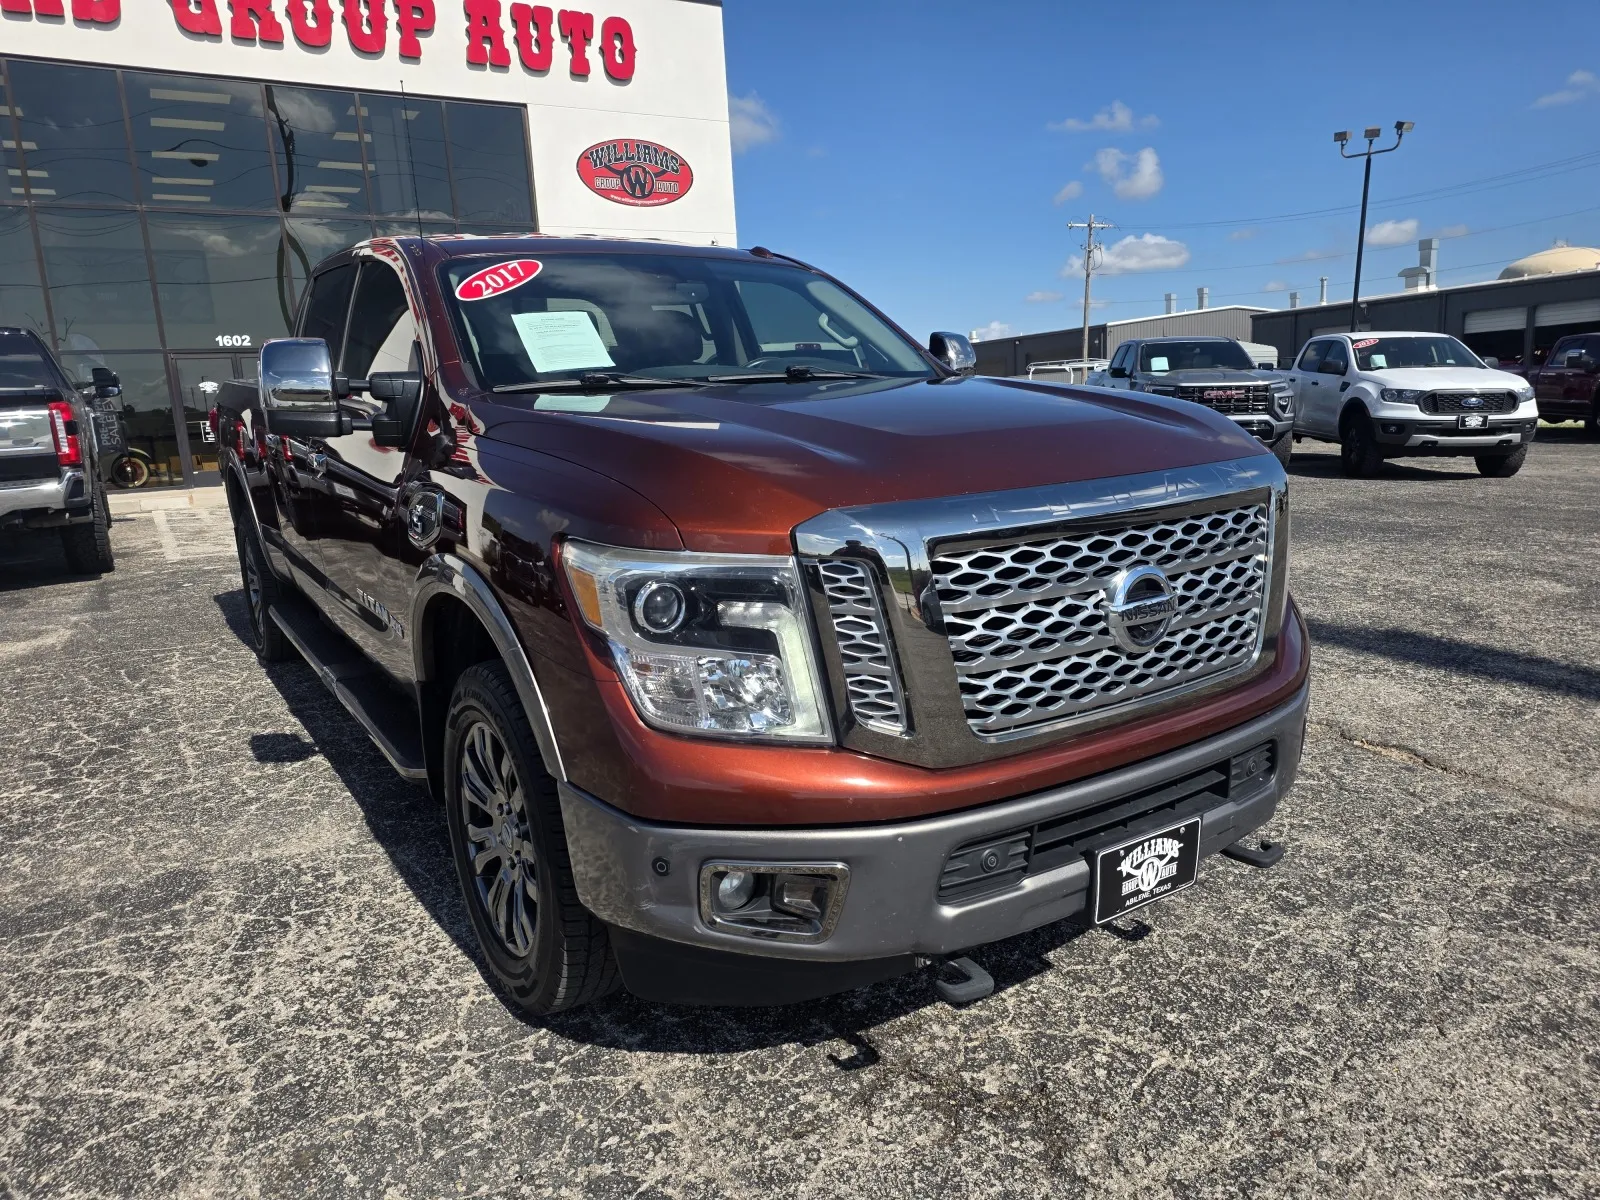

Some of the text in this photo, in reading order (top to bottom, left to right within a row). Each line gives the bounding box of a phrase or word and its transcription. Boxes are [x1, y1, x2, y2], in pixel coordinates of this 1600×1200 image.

[463, 0, 638, 80] AUTO
[589, 142, 680, 175] WILLIAMS
[595, 177, 679, 193] GROUP AUTO
[623, 166, 651, 197] W
[472, 262, 525, 297] 2017
[215, 335, 252, 347] 1602
[1203, 390, 1246, 399] GMC
[105, 414, 122, 445] SALE
[356, 587, 391, 625] TITAN
[1118, 597, 1176, 622] NISSAN
[1120, 838, 1179, 877] WILLIAMS
[1122, 864, 1178, 894] GROUP AUTO
[1152, 883, 1172, 895] TEXAS
